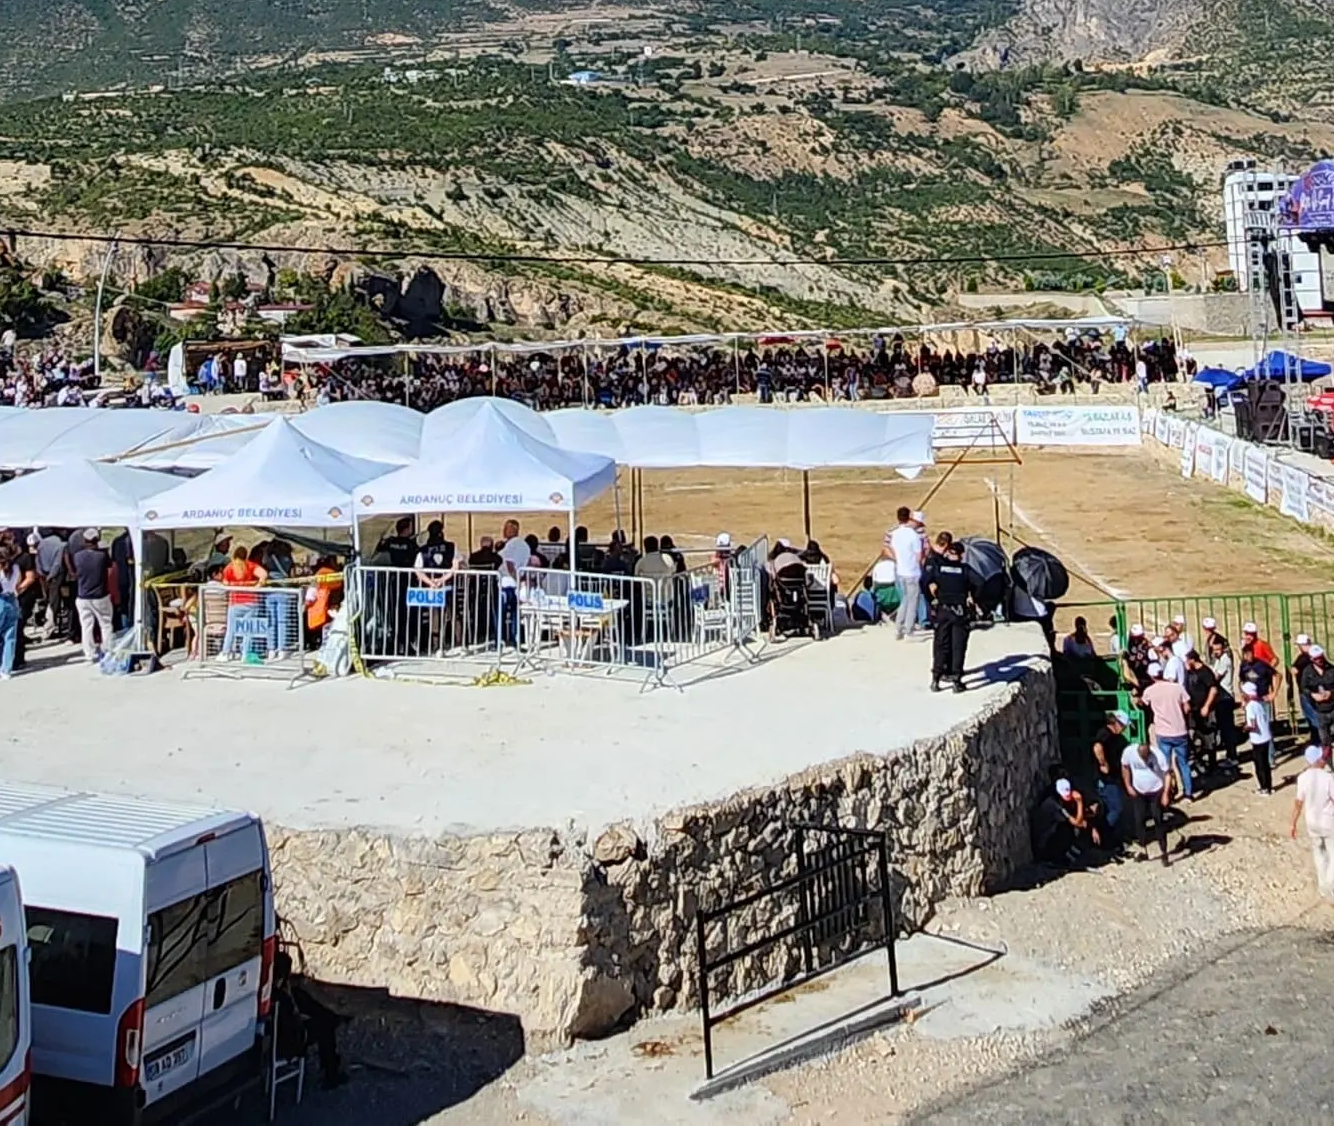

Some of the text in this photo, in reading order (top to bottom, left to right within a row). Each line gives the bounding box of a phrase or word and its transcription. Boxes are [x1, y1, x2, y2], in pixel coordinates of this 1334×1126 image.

[399, 492, 523, 505] ARDANUÇ BELEDİYESİ
[182, 507, 302, 519] ARDANUÇ BELEDİYESİ
